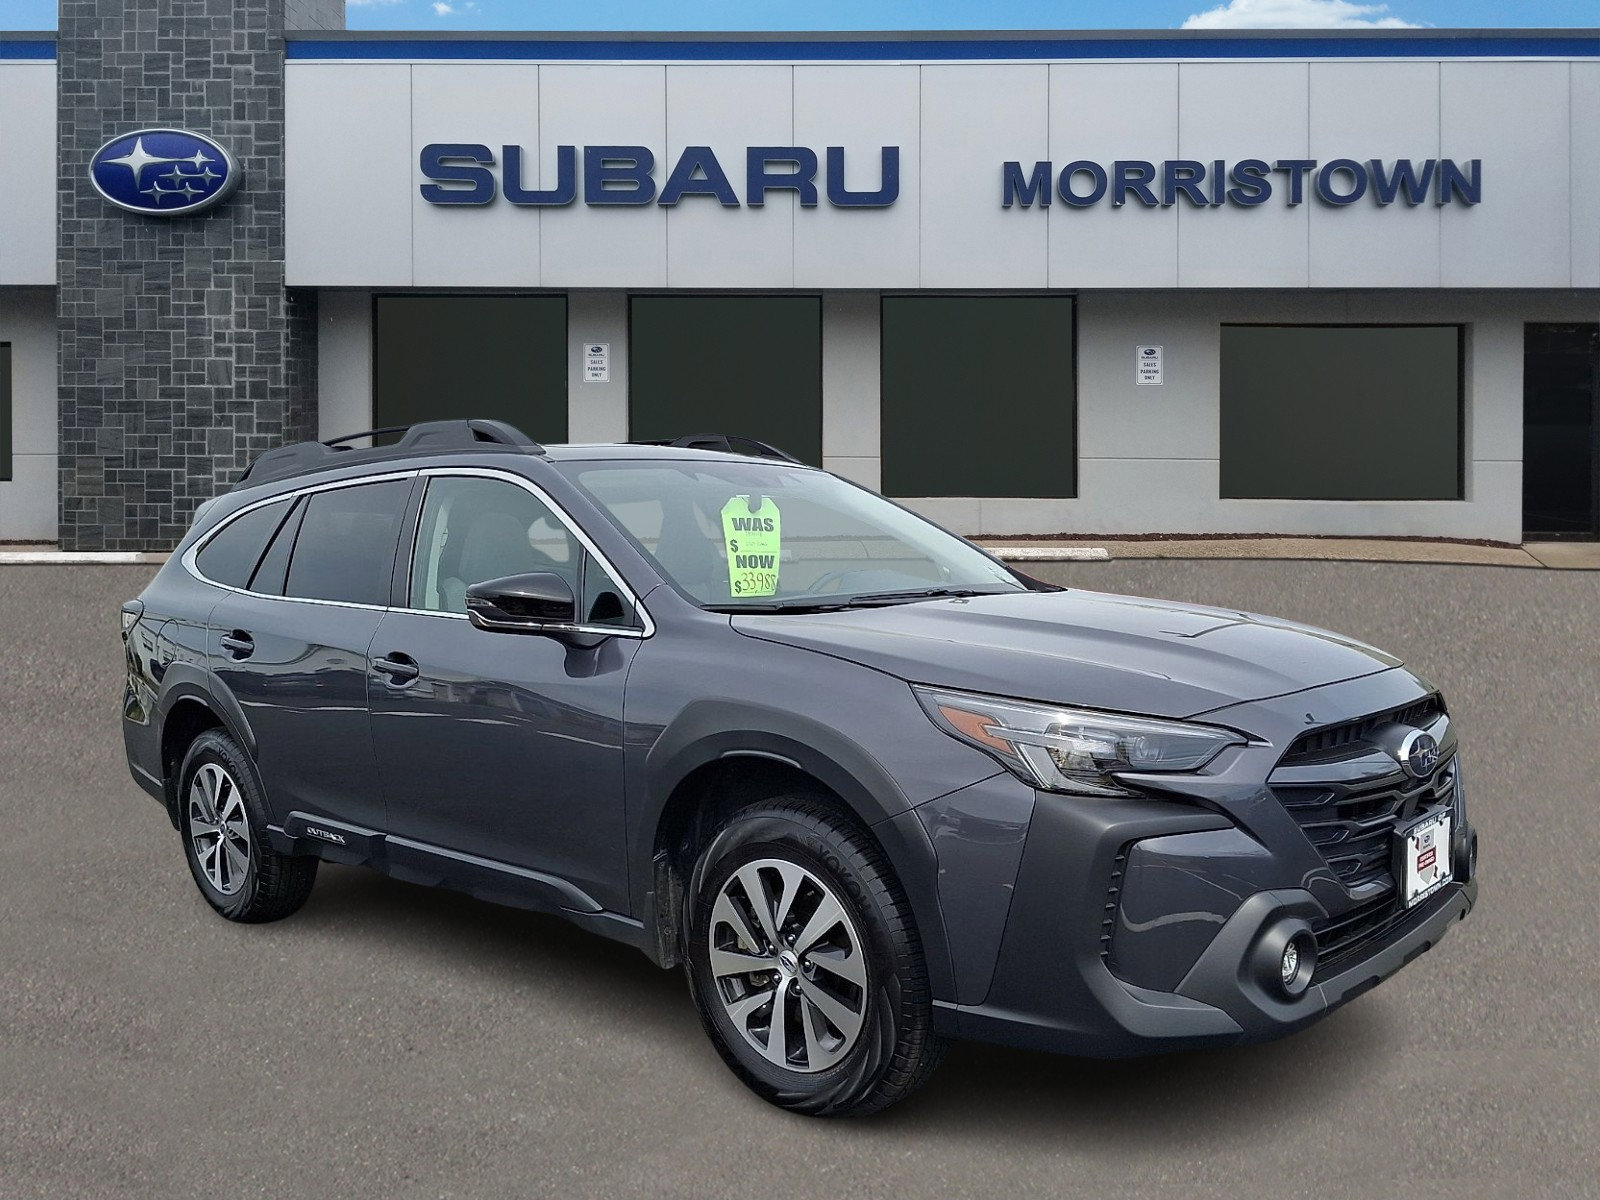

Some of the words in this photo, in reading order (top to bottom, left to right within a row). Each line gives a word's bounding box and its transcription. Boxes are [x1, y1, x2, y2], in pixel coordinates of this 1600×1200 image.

[419, 143, 899, 207] SUBARU
[1002, 158, 1482, 208] MORRISTOWN
[732, 517, 774, 532] WAS
[730, 539, 739, 553] $
[736, 555, 775, 569] NOW
[1413, 817, 1437, 834] SUBARU
[306, 826, 346, 844] OUTBACK
